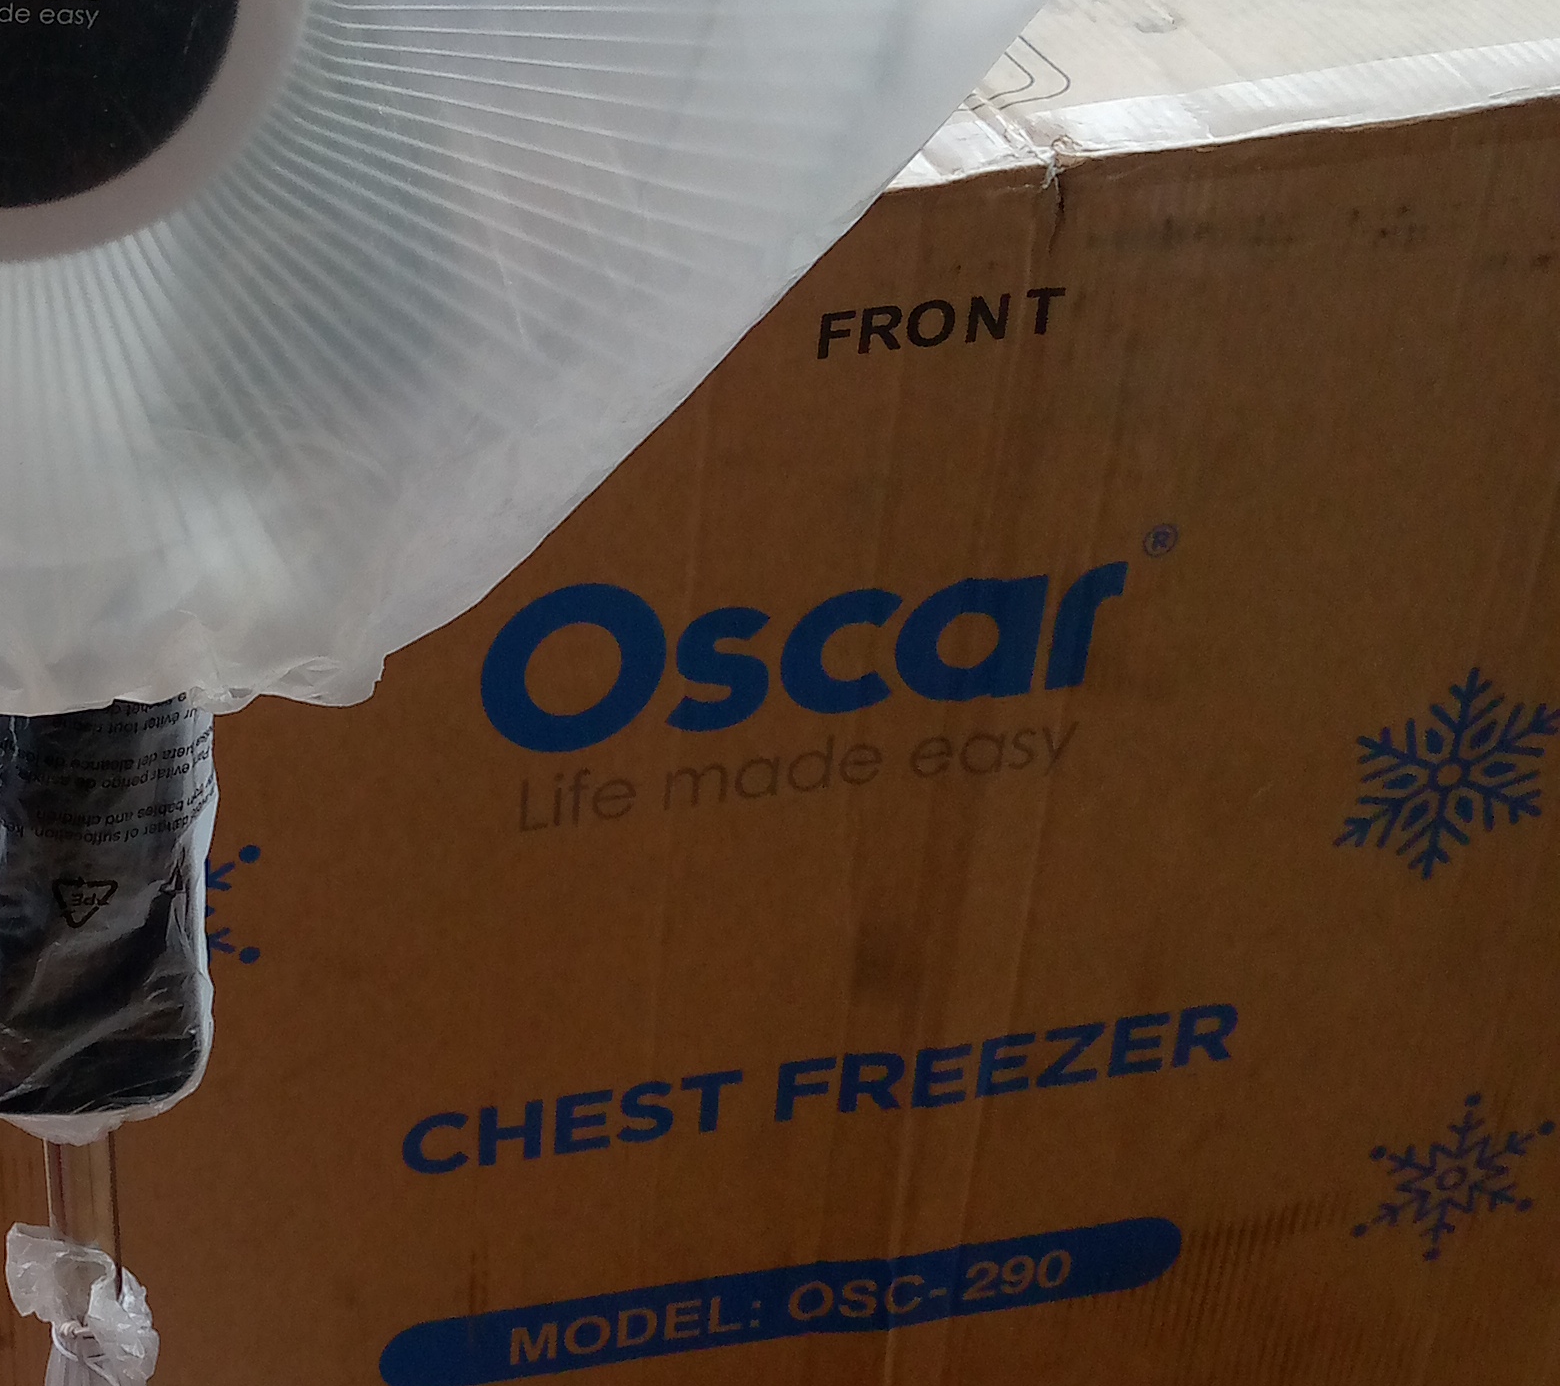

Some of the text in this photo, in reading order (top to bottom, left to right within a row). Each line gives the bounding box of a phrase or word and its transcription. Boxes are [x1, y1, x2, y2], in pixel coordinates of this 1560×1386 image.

[40, 8, 100, 29] easy
[816, 287, 1066, 360] FRONT
[480, 560, 1129, 754] Oscar
[138, 753, 158, 770] del
[151, 764, 190, 781] evitar
[518, 719, 1080, 834] Life made easy
[105, 812, 133, 826] and
[138, 801, 184, 819] babies
[124, 828, 139, 843] of
[401, 1003, 1241, 1175] CHEST FREEZER
[507, 1292, 763, 1367] MODEL:
